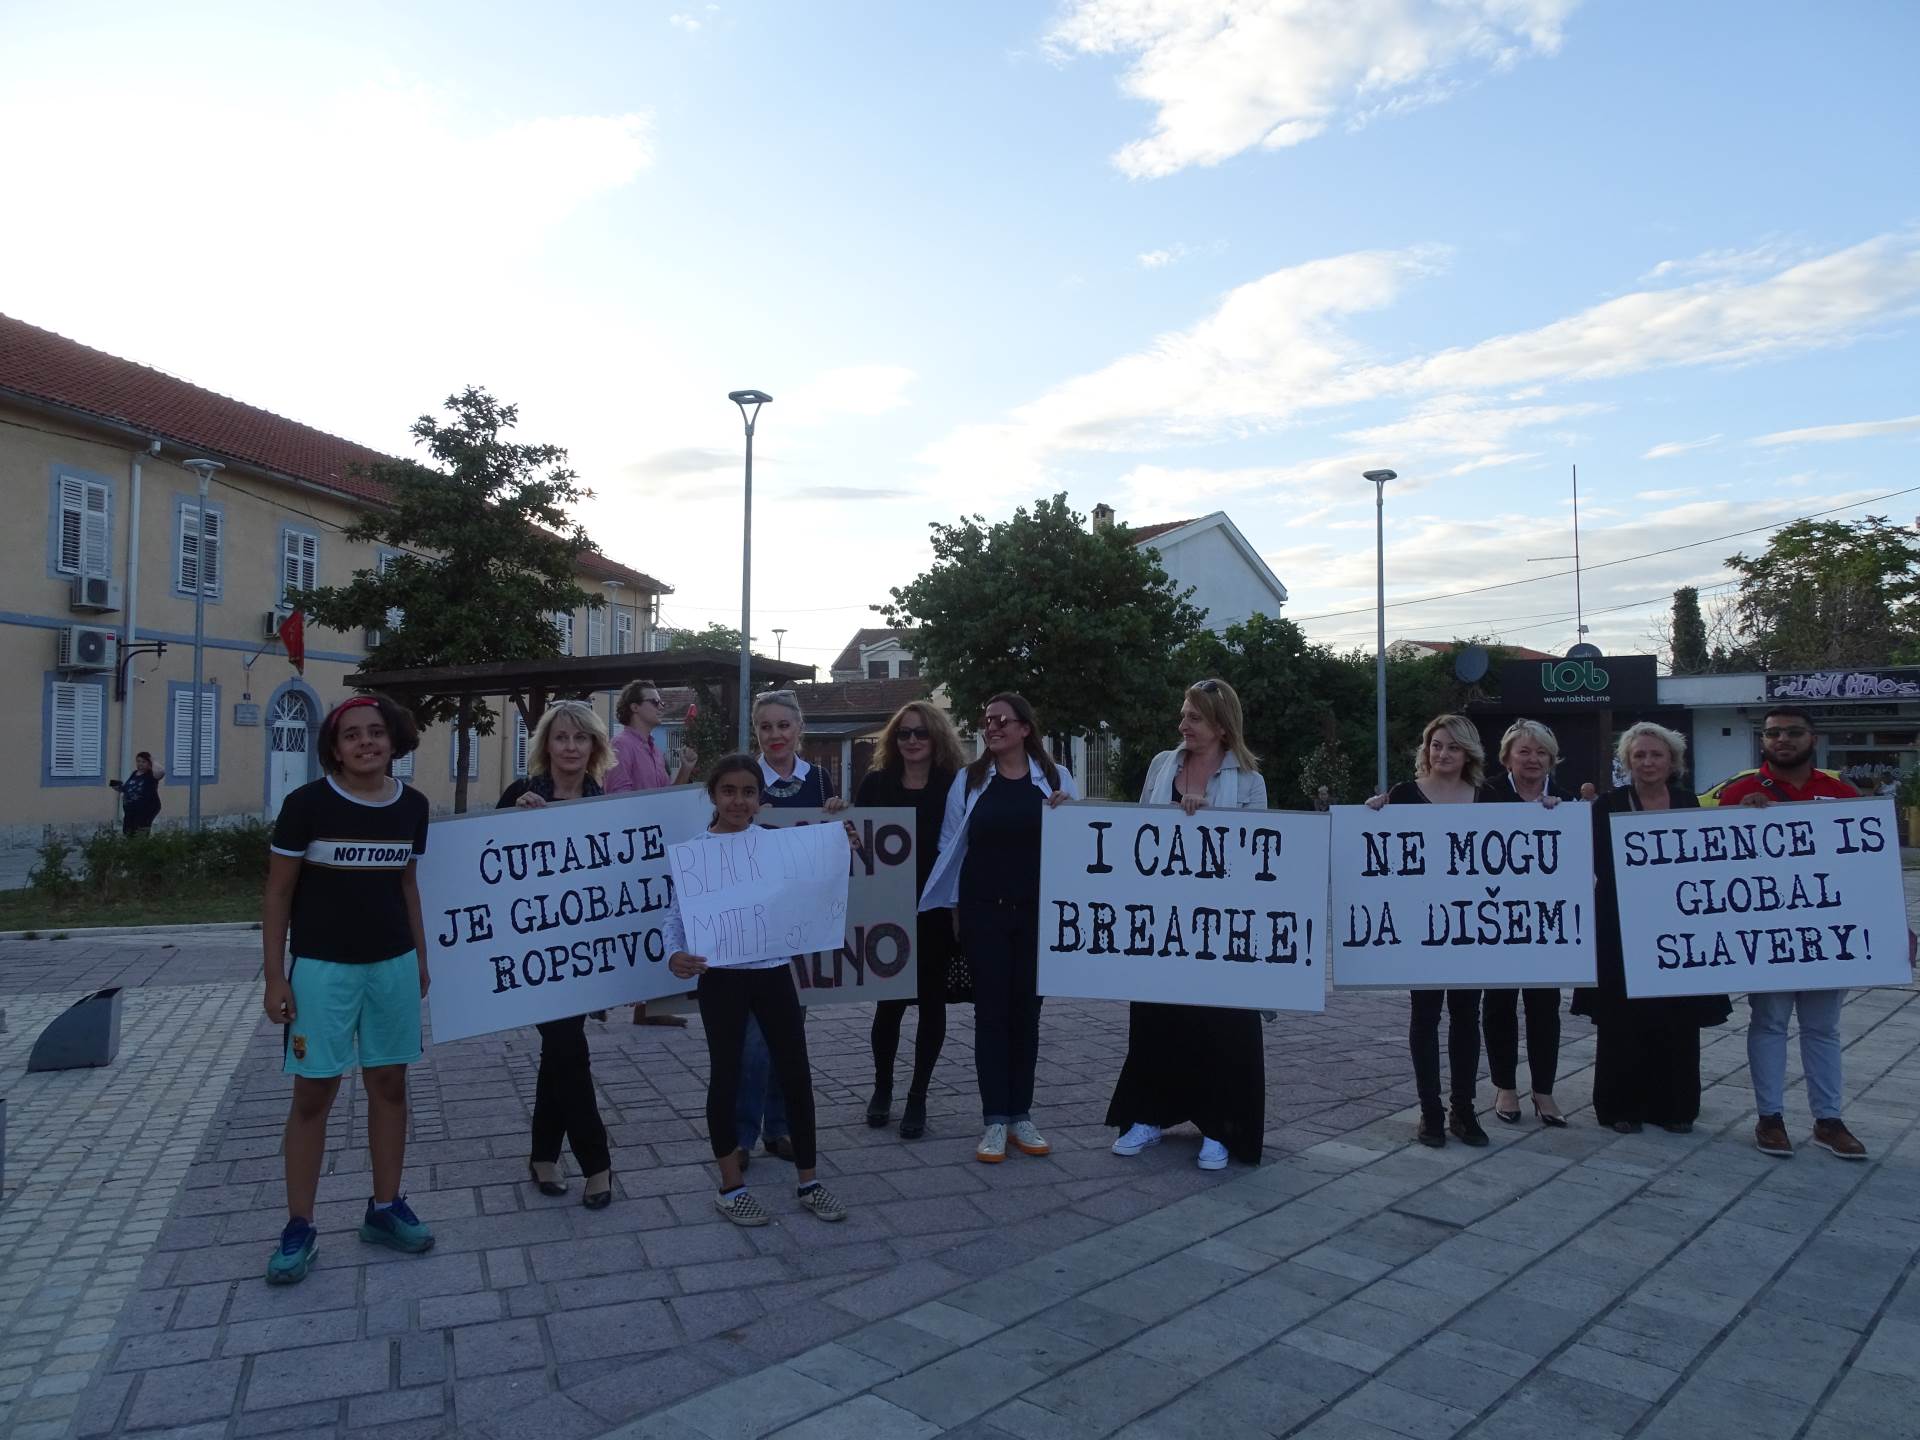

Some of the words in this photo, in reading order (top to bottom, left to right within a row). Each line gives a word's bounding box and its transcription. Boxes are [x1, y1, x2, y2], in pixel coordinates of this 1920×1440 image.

[1543, 695, 1610, 703] www.lobbet.me
[334, 847, 366, 861] NOT
[368, 848, 411, 861] TODAY
[480, 825, 665, 884] ĆUTANJE
[1087, 822, 1113, 874] I
[1135, 824, 1281, 881] CAN'T
[1361, 832, 1425, 876] NE
[1446, 830, 1561, 875] MOGU
[1625, 821, 1815, 866] SILENCE
[1833, 817, 1884, 854] IS
[675, 836, 762, 898] BLACK
[1343, 902, 1401, 947] DA
[1421, 886, 1581, 946] DIŠEM!
[1676, 873, 1841, 915] GLOBAL
[439, 904, 493, 947] JE
[1050, 900, 1312, 966] BREATHE!
[1657, 925, 1871, 969] SLAVERY!
[490, 928, 665, 993] ROPSTVO
